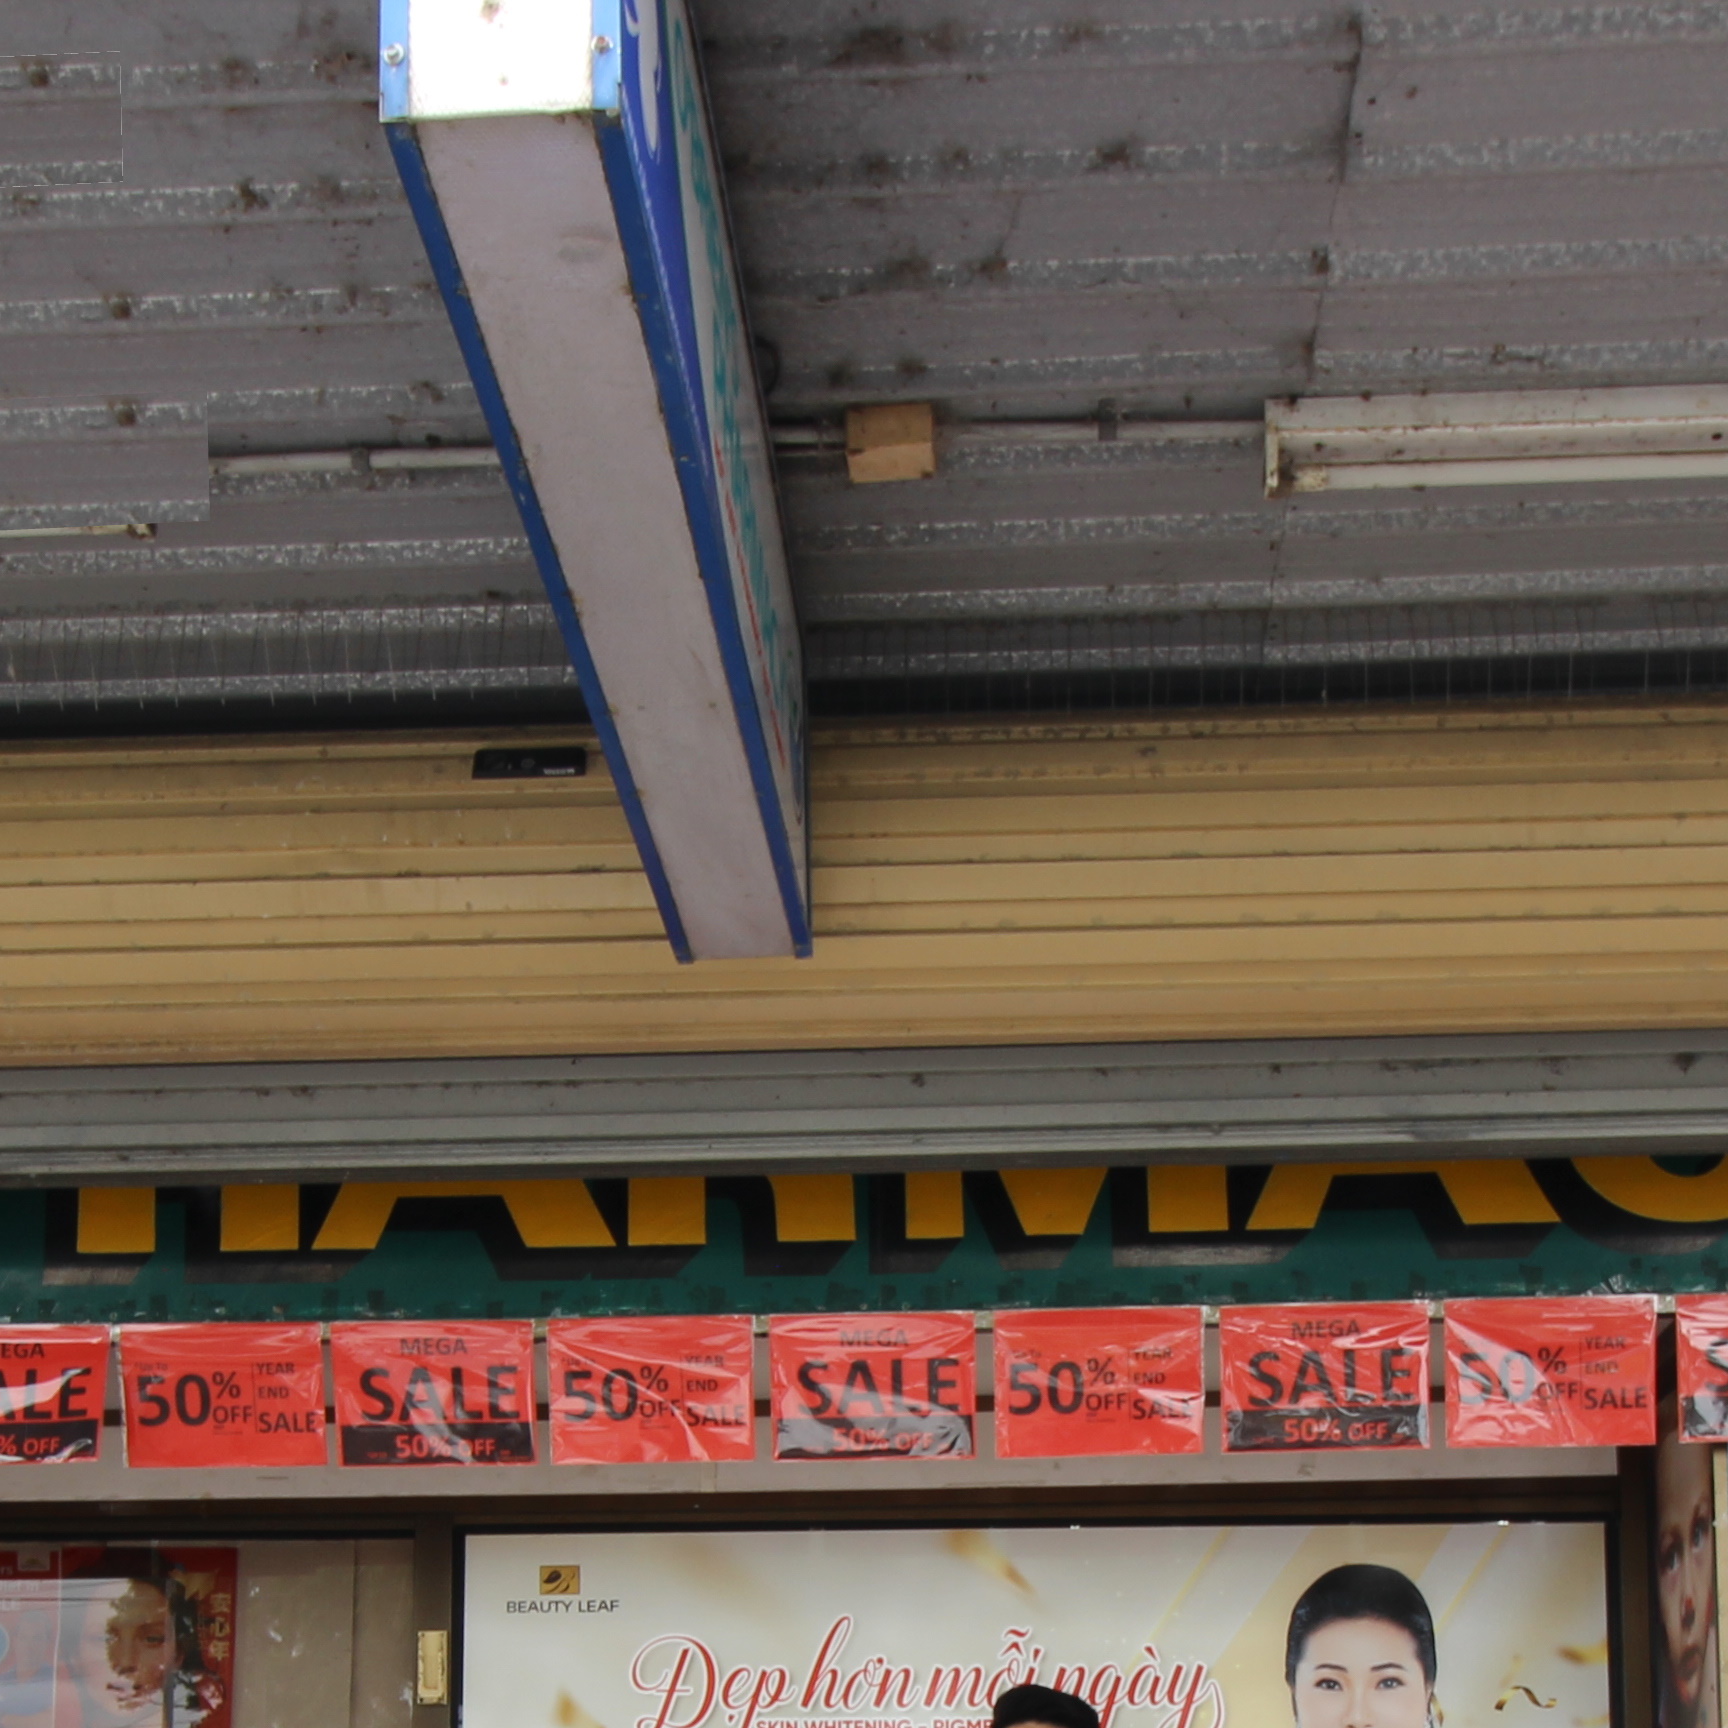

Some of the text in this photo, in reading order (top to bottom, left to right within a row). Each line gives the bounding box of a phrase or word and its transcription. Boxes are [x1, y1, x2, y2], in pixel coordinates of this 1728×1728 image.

[1292, 1319, 1360, 1338] MEGA
[400, 1338, 467, 1355] MEGA
[1134, 1346, 1173, 1360] YEAR
[1585, 1337, 1625, 1350] YEAR
[254, 1361, 296, 1376] YEAR
[1248, 1347, 1415, 1408] SALE
[686, 1380, 718, 1393] END
[797, 1357, 960, 1417] SALE
[1134, 1372, 1166, 1385] END
[258, 1385, 290, 1400] END
[359, 1365, 519, 1422] SALE
[1585, 1387, 1648, 1410] SALE
[257, 1410, 318, 1434] SALE
[685, 1405, 746, 1428] SALE
[1284, 1418, 1388, 1441] 50% OFF
[22, 1436, 60, 1455] OFF
[394, 1437, 450, 1459] 50%
[507, 1599, 620, 1613] BEAUTY LEAF
[799, 1615, 927, 1709] hơn
